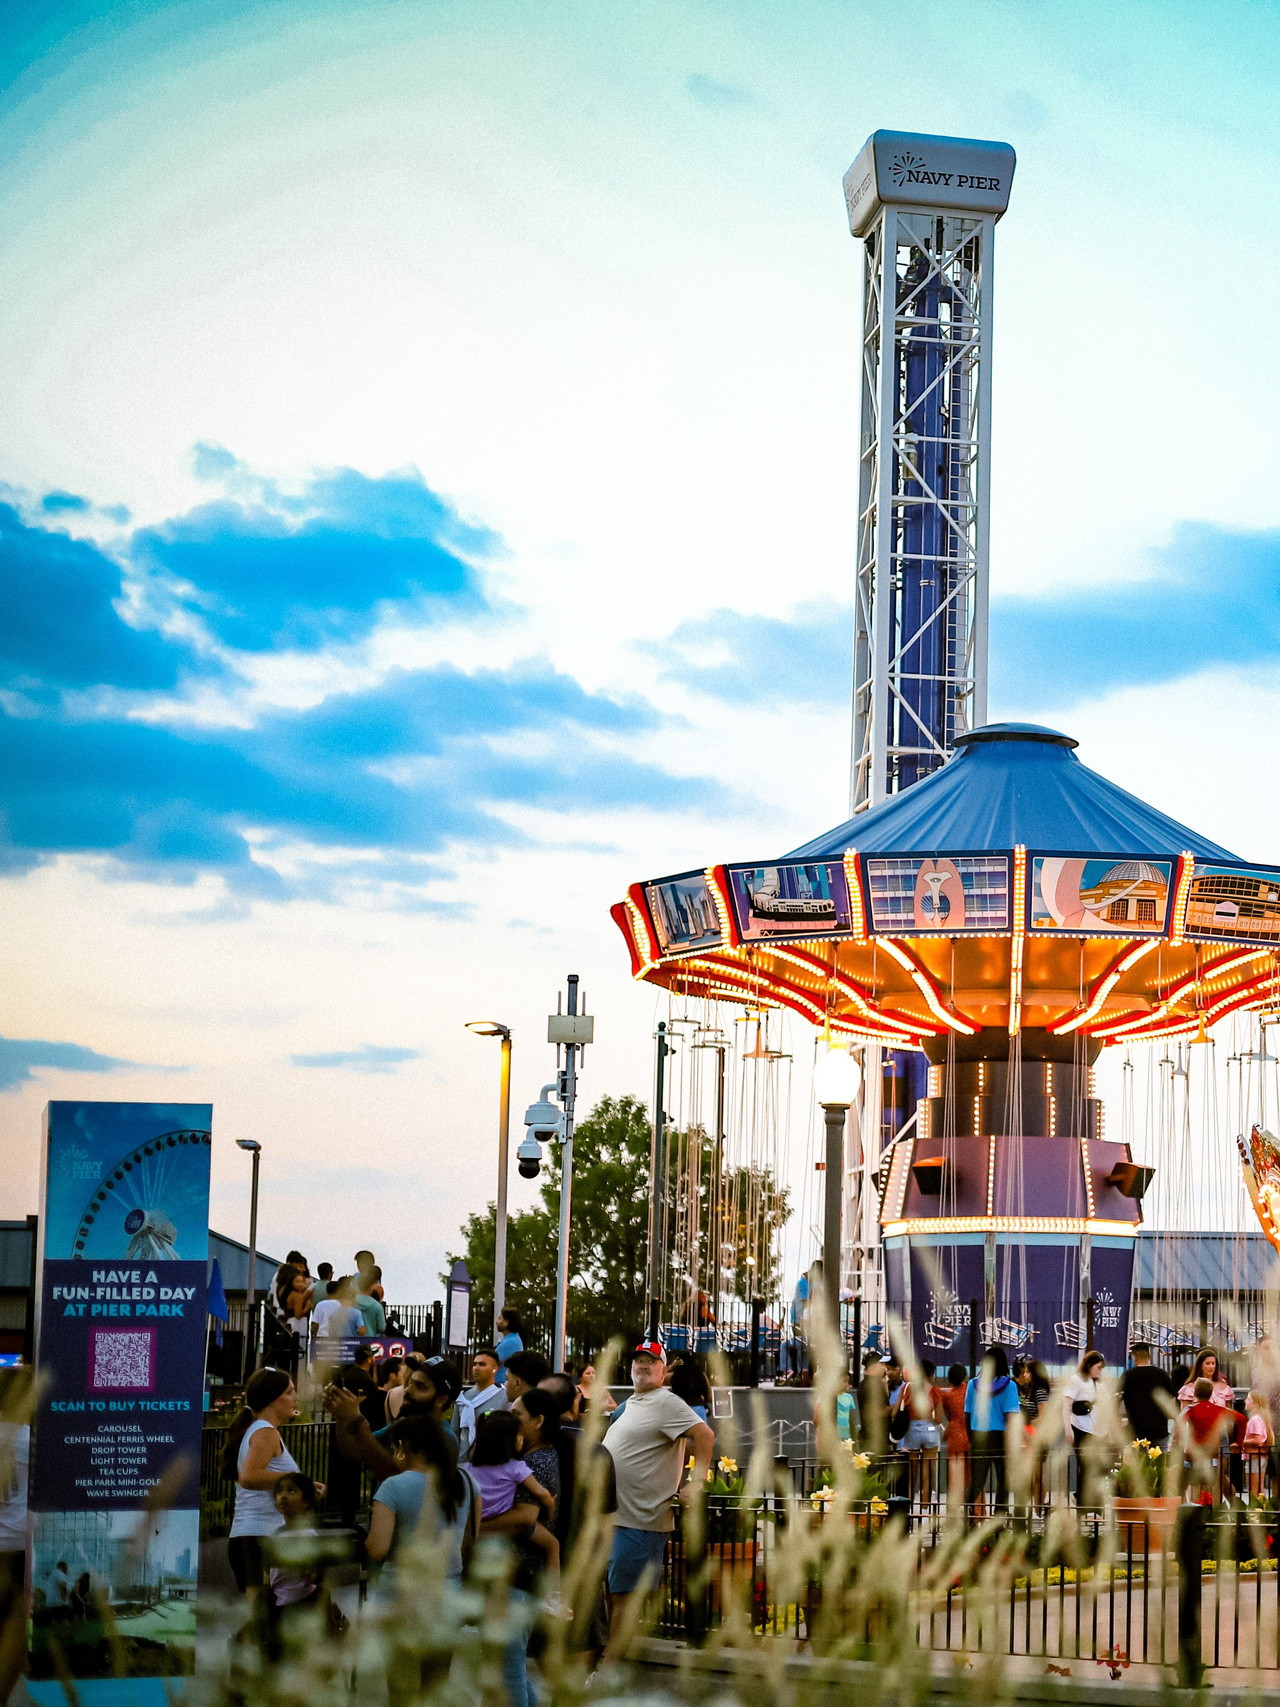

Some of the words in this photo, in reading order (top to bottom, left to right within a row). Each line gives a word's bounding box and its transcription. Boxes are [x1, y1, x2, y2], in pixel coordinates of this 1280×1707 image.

[906, 169, 954, 187] NAVY
[957, 174, 1001, 192] PIER
[72, 1161, 104, 1171] NAVY
[72, 1170, 101, 1180] PIER
[92, 1270, 141, 1284] HAVE
[144, 1270, 158, 1284] A
[52, 1287, 156, 1300] FUN-FILLED
[159, 1287, 196, 1300] DAY
[63, 1304, 87, 1317] AT
[91, 1304, 131, 1317] PIER
[135, 1304, 185, 1317] PARK
[942, 1315, 972, 1326] PIER
[50, 1401, 85, 1412] SCAN
[88, 1401, 106, 1412] TO
[109, 1401, 136, 1411] BUY
[138, 1401, 191, 1411] TICKETS
[98, 1425, 142, 1433] CAROUSEL
[64, 1436, 116, 1444] CENTENNIAL
[147, 1435, 175, 1443] WHEEL
[90, 1457, 115, 1465] LIGHT
[117, 1457, 148, 1465] TOWER
[99, 1468, 115, 1476] TEA
[116, 1468, 139, 1476] CUPS
[75, 1479, 93, 1487] PIER
[111, 1489, 150, 1497] SWINGER
